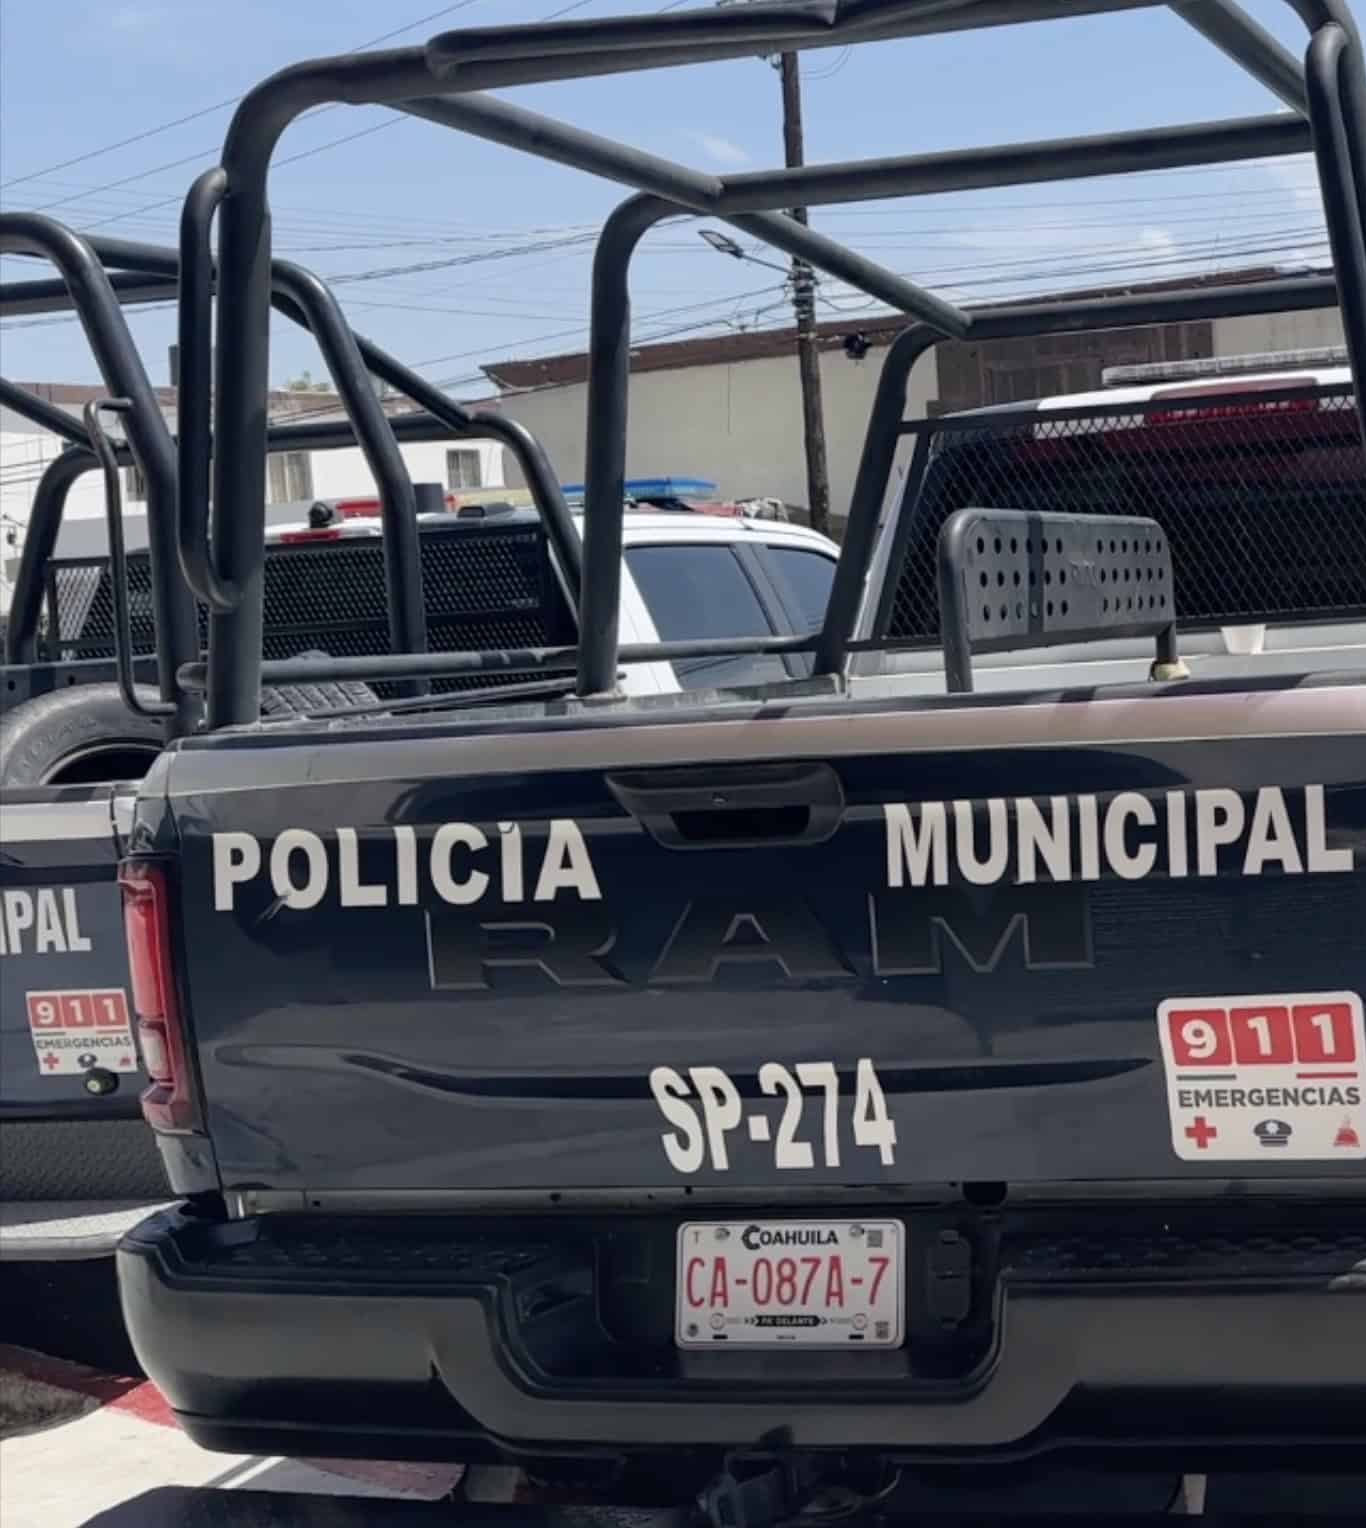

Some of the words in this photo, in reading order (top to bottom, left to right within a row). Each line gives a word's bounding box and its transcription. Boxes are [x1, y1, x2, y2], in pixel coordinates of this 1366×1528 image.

[884, 784, 1354, 888] MUNICIPAL
[424, 890, 1096, 992] RAM
[36, 997, 119, 1024] 911
[36, 1035, 131, 1050] EMERGENCIAS
[1181, 1013, 1336, 1058] 911
[649, 1058, 897, 1173] SP-274
[1178, 1087, 1361, 1109] EMERGENCIAS
[741, 1224, 839, 1250] COAHUILA
[687, 1256, 889, 1308] CA-087A-7
